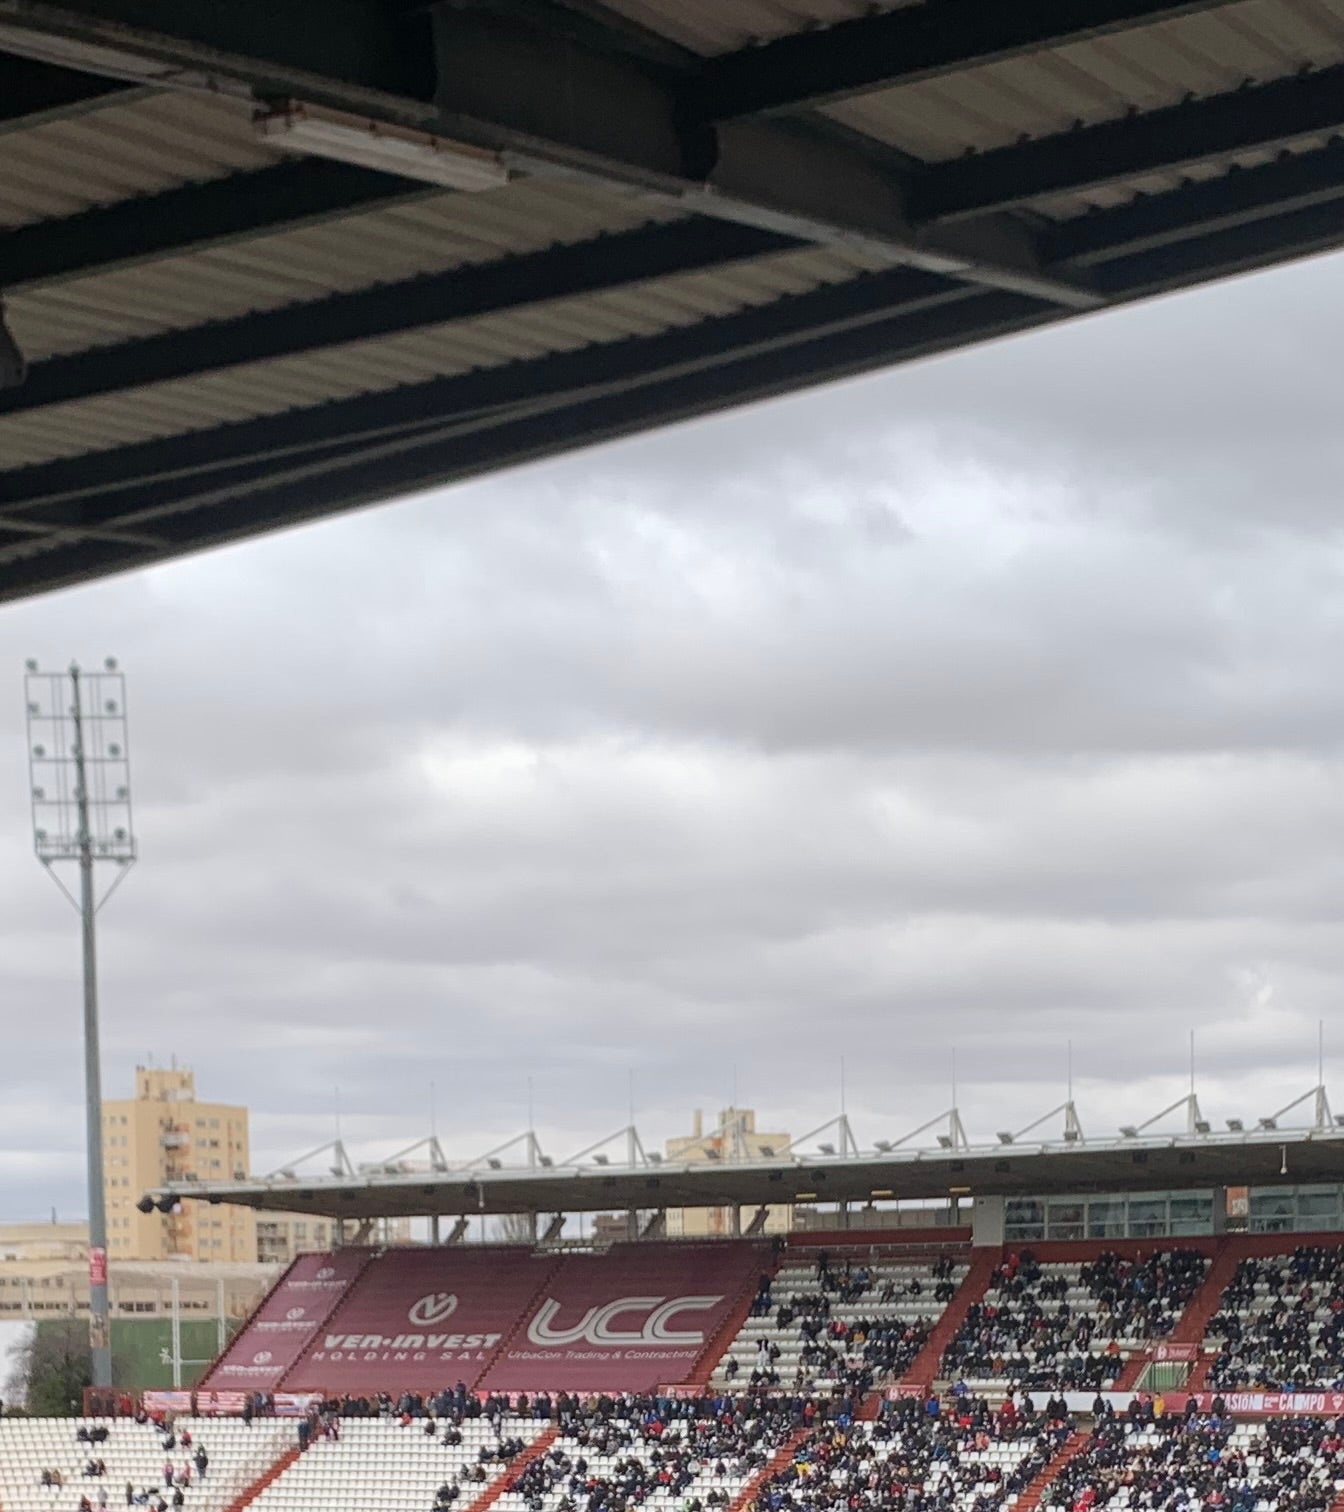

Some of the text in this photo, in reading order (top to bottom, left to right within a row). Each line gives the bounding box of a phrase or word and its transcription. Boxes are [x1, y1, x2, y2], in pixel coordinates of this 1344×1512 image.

[527, 1295, 728, 1346] UCC
[310, 1350, 487, 1361] HOLDING SAL
[507, 1349, 562, 1361] UrbaCon
[565, 1350, 611, 1362] Trading
[625, 1349, 699, 1362] Contracting
